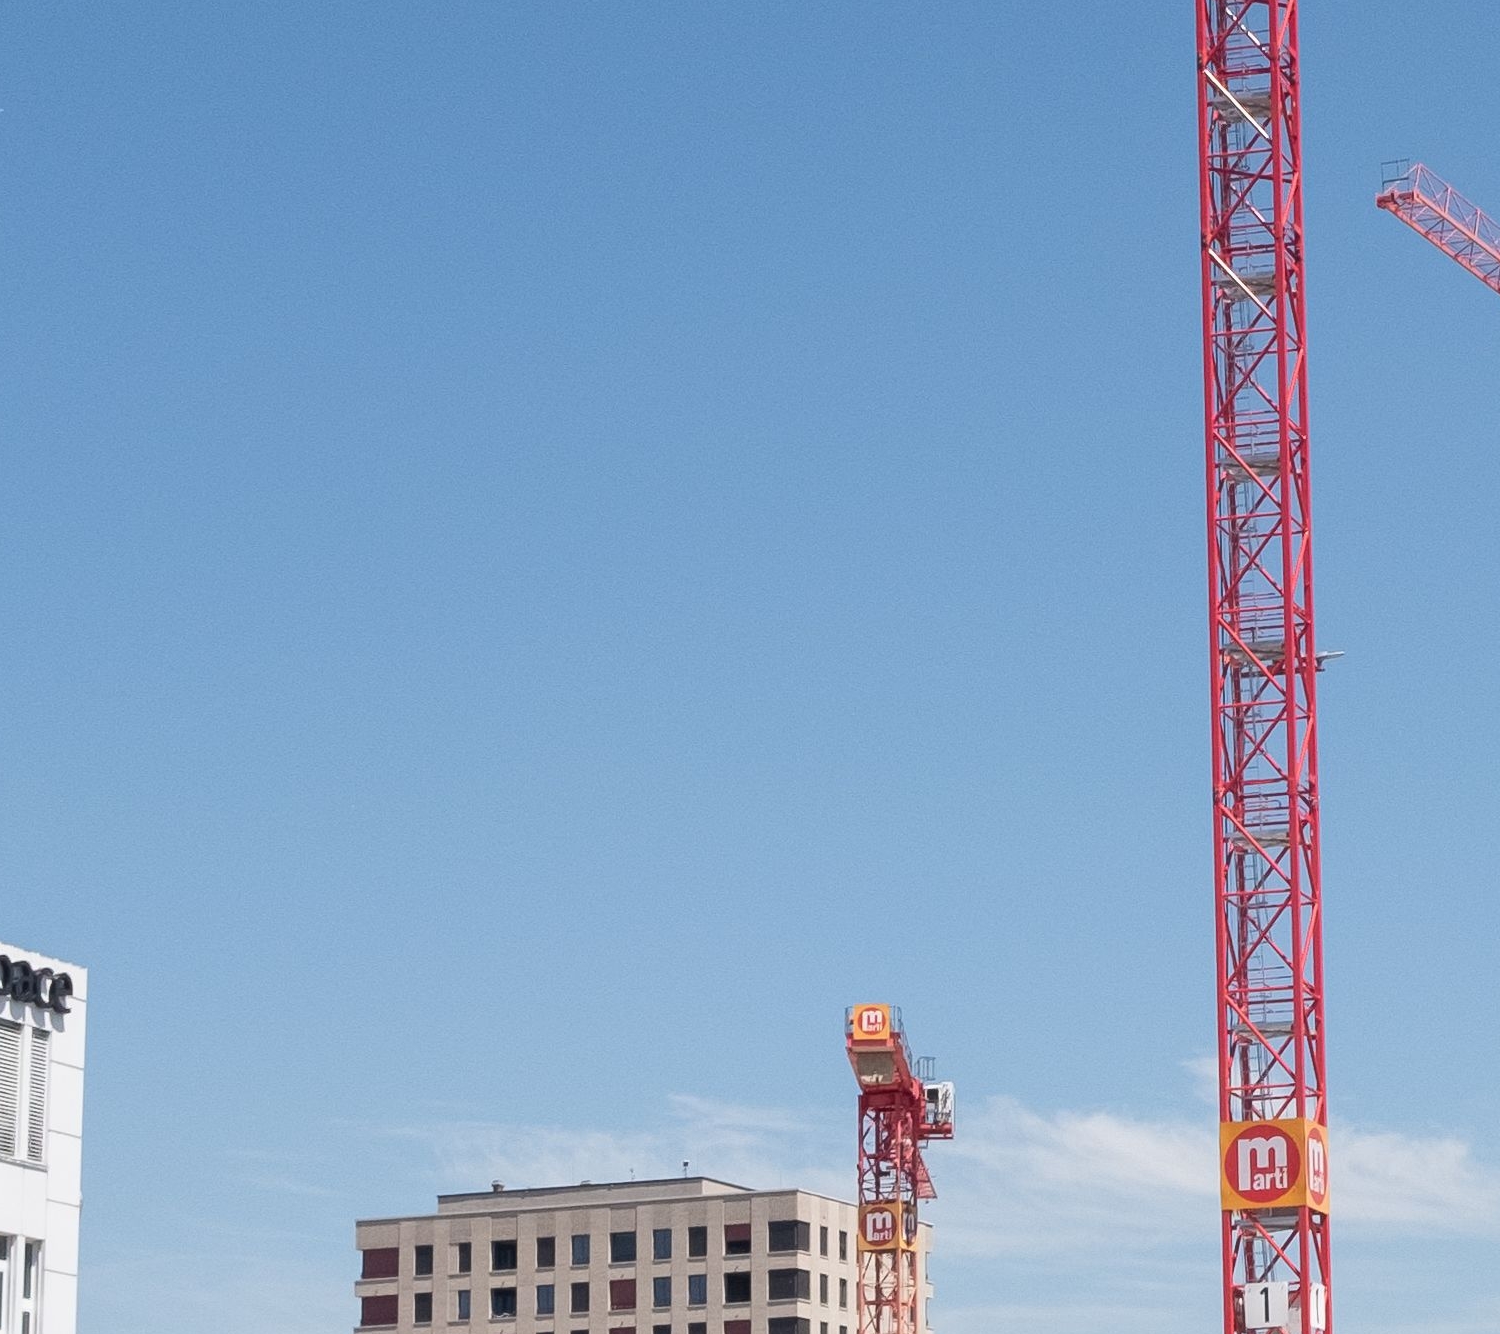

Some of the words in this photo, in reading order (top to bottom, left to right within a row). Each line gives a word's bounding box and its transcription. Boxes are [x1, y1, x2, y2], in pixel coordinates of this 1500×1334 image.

[1237, 1134, 1288, 1192] marti
[865, 1210, 893, 1243] marti
[1259, 1286, 1270, 1323] 1
